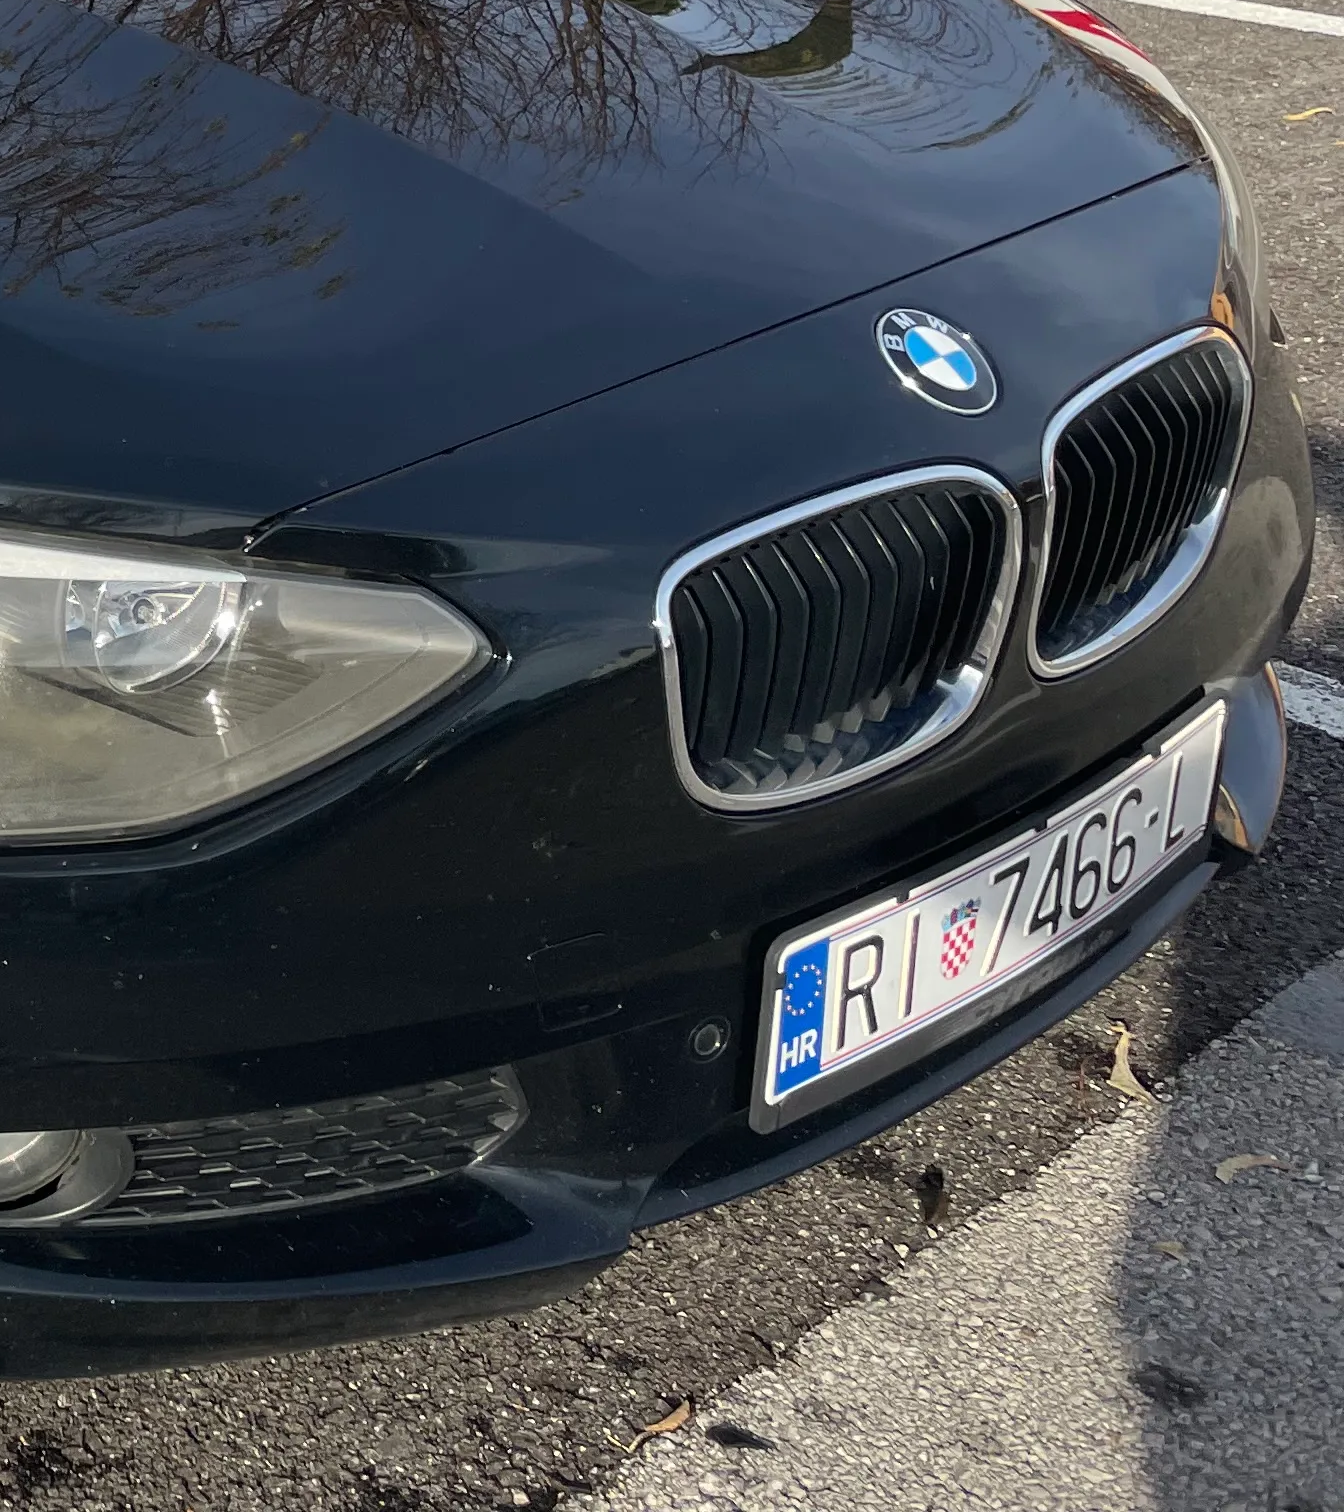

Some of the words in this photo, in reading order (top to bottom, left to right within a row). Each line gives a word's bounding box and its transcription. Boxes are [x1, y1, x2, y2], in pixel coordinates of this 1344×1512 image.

[884, 312, 949, 353] BMW
[831, 908, 921, 1053] RI
[979, 752, 1186, 978] 7466-L
[780, 1028, 818, 1073] HR
